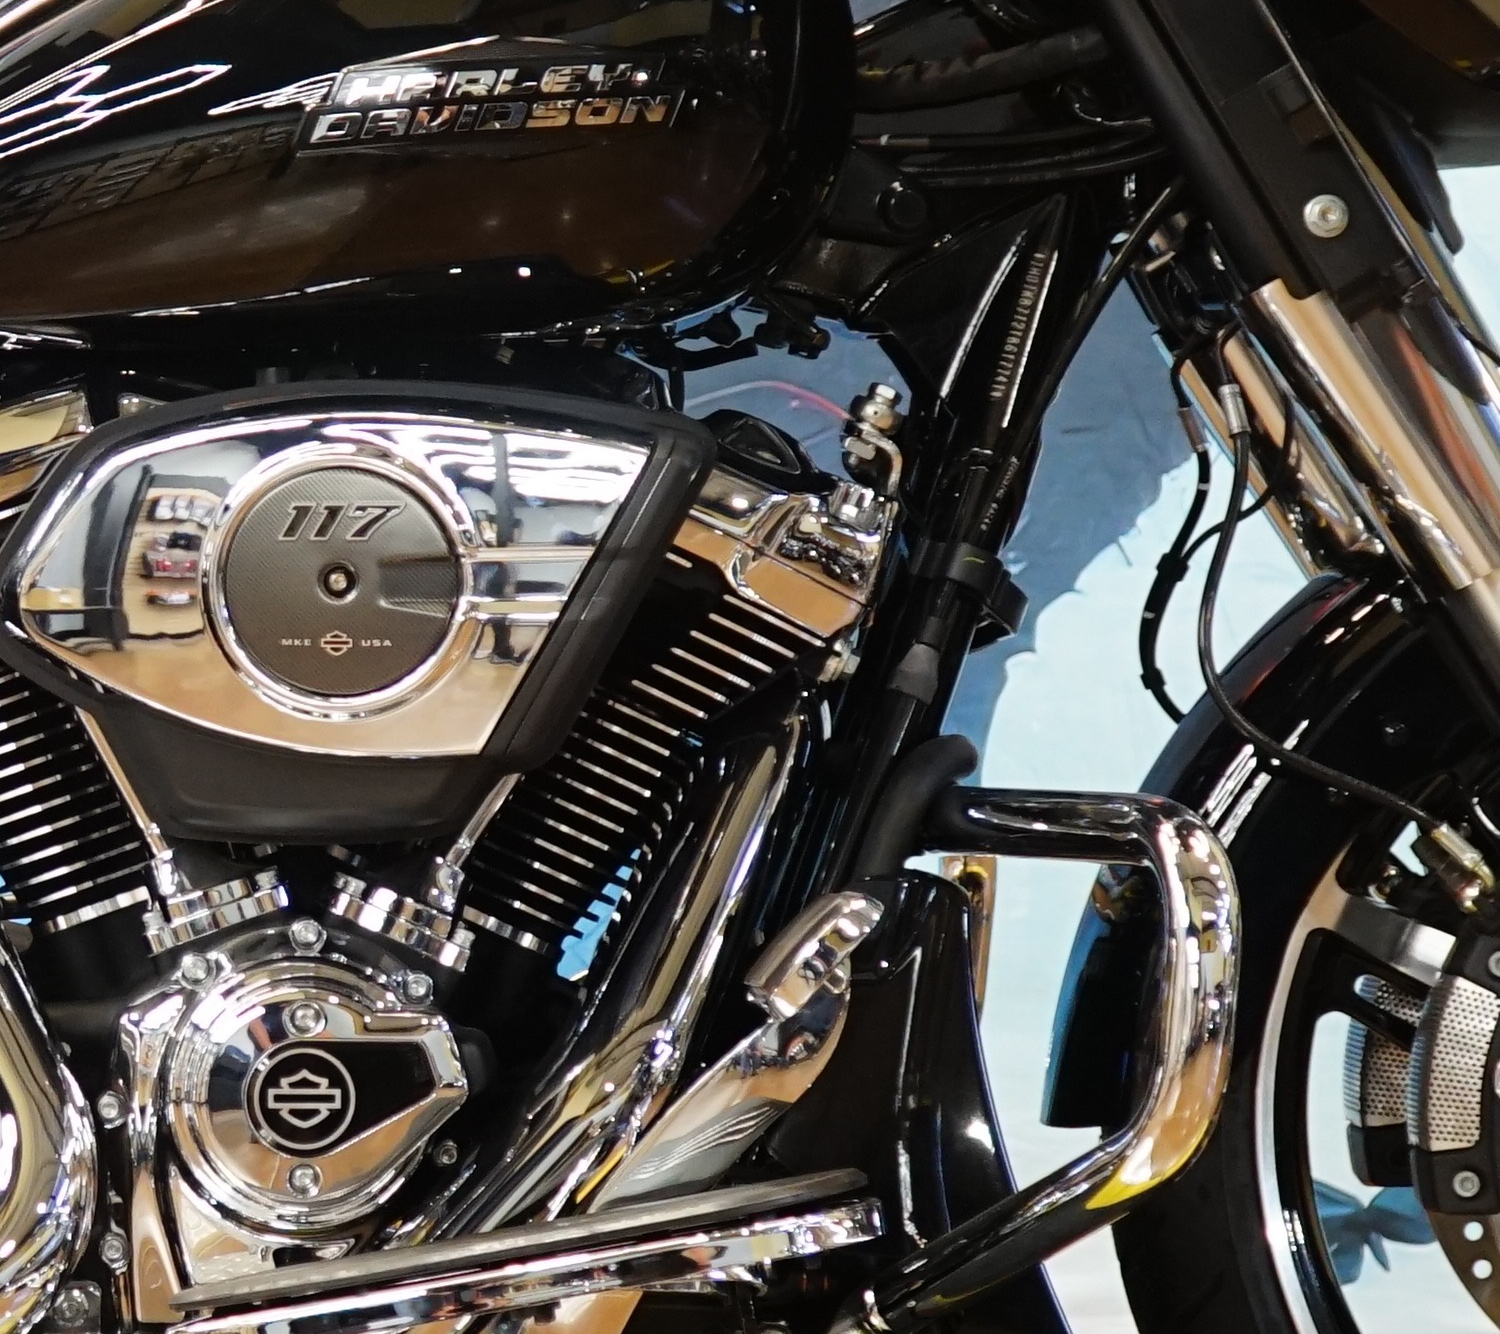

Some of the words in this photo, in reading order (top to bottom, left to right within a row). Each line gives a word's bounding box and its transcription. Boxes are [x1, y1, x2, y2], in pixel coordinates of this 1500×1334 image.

[310, 95, 671, 143] DAVIDSON
[278, 501, 407, 540] 117
[281, 638, 312, 647] MKE
[361, 638, 392, 647] USA
